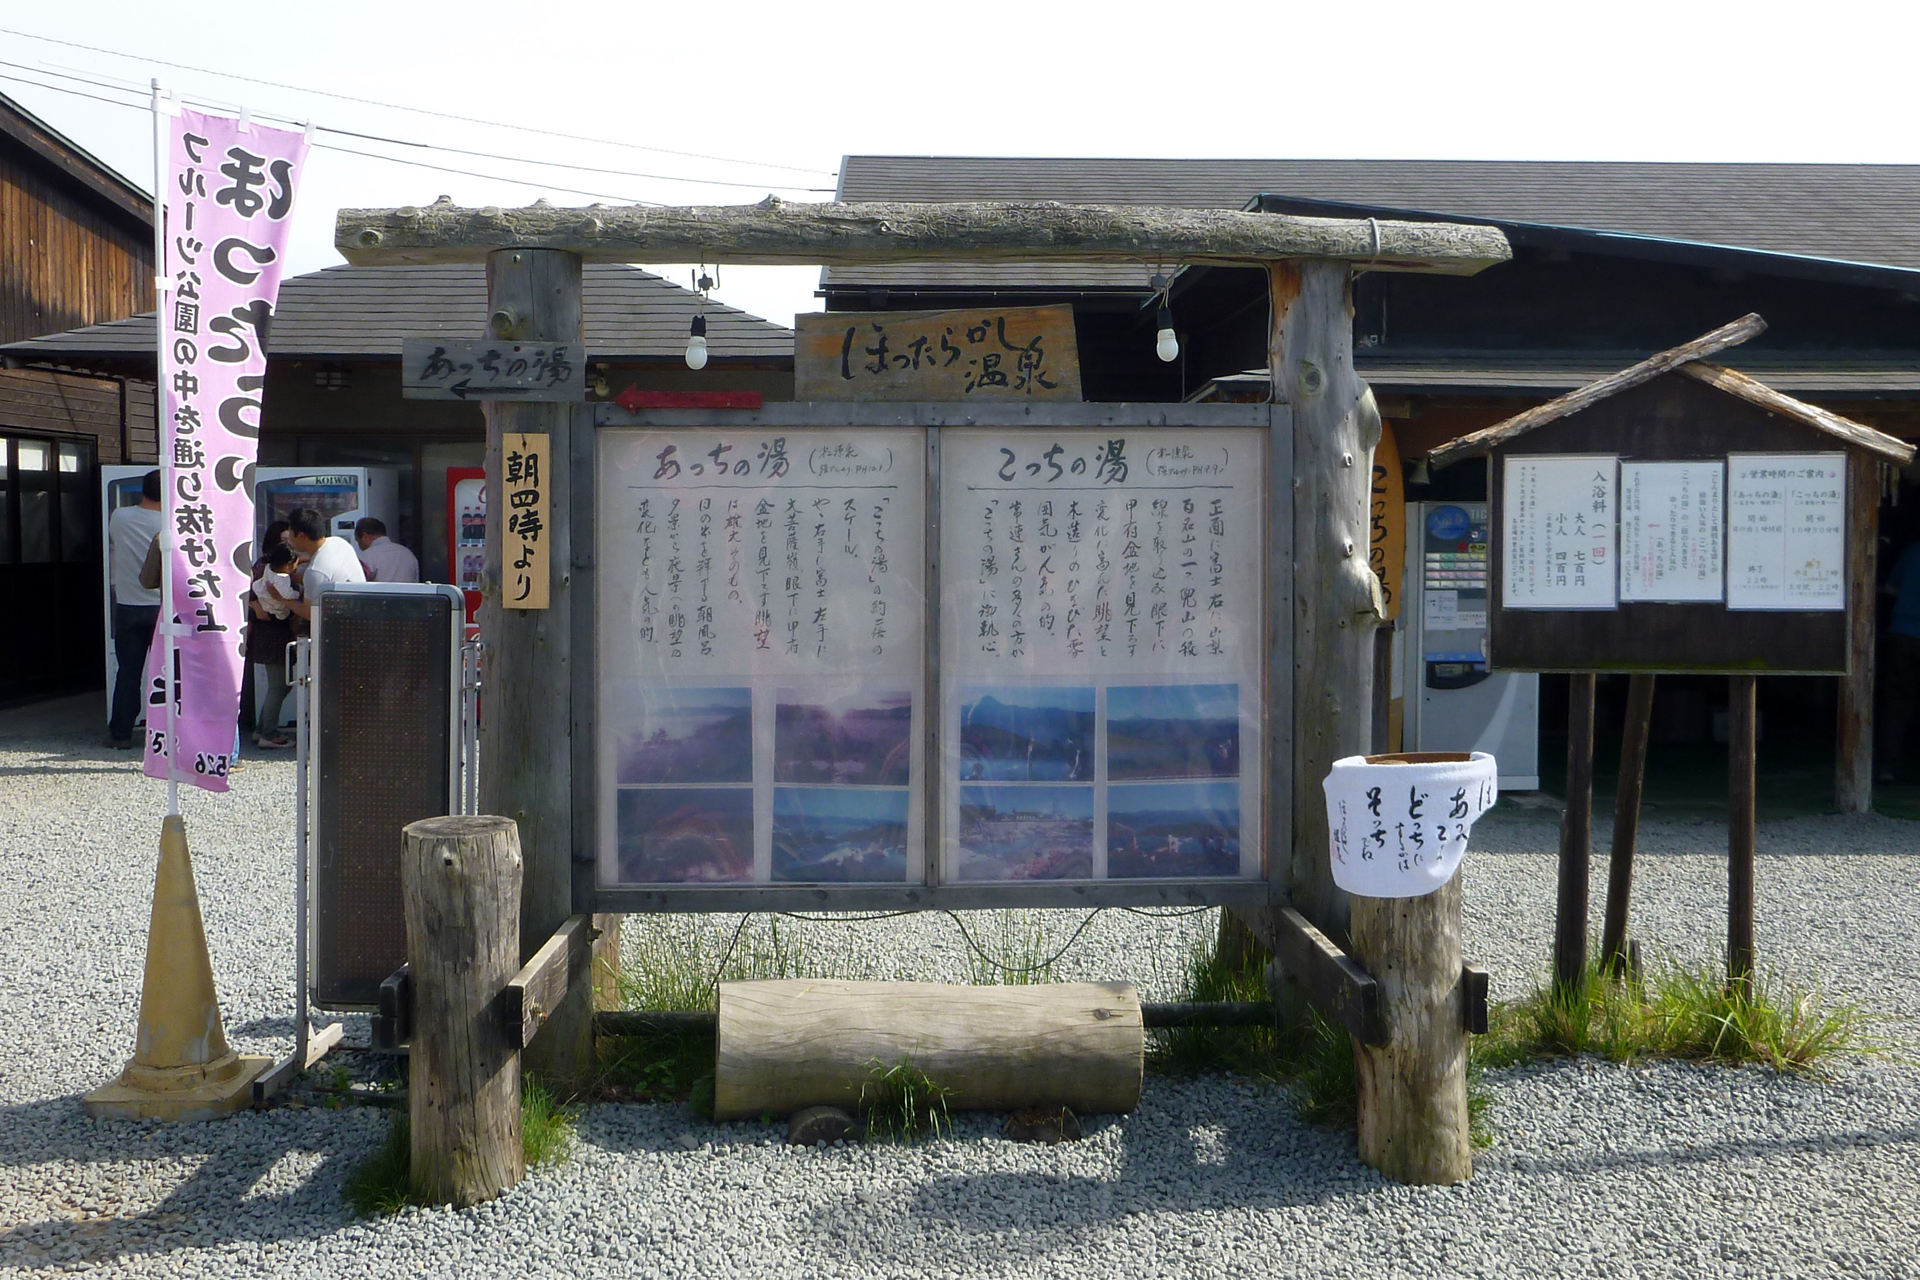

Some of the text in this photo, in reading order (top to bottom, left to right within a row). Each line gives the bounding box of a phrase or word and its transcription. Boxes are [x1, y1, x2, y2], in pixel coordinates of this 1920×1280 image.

[419, 346, 572, 388] あっちの湯
[841, 316, 1027, 380] ほったらかし
[965, 335, 1058, 394] 温泉
[315, 475, 353, 485] KOIWAI
[653, 437, 790, 480] あっちの湯
[999, 438, 1130, 485] こっちの湯
[1750, 469, 1824, 479] 営業時間のご案内
[505, 451, 544, 602] 朝四時より
[1555, 512, 1567, 586] 小人 四百円
[1573, 512, 1586, 586] 大人 七百円
